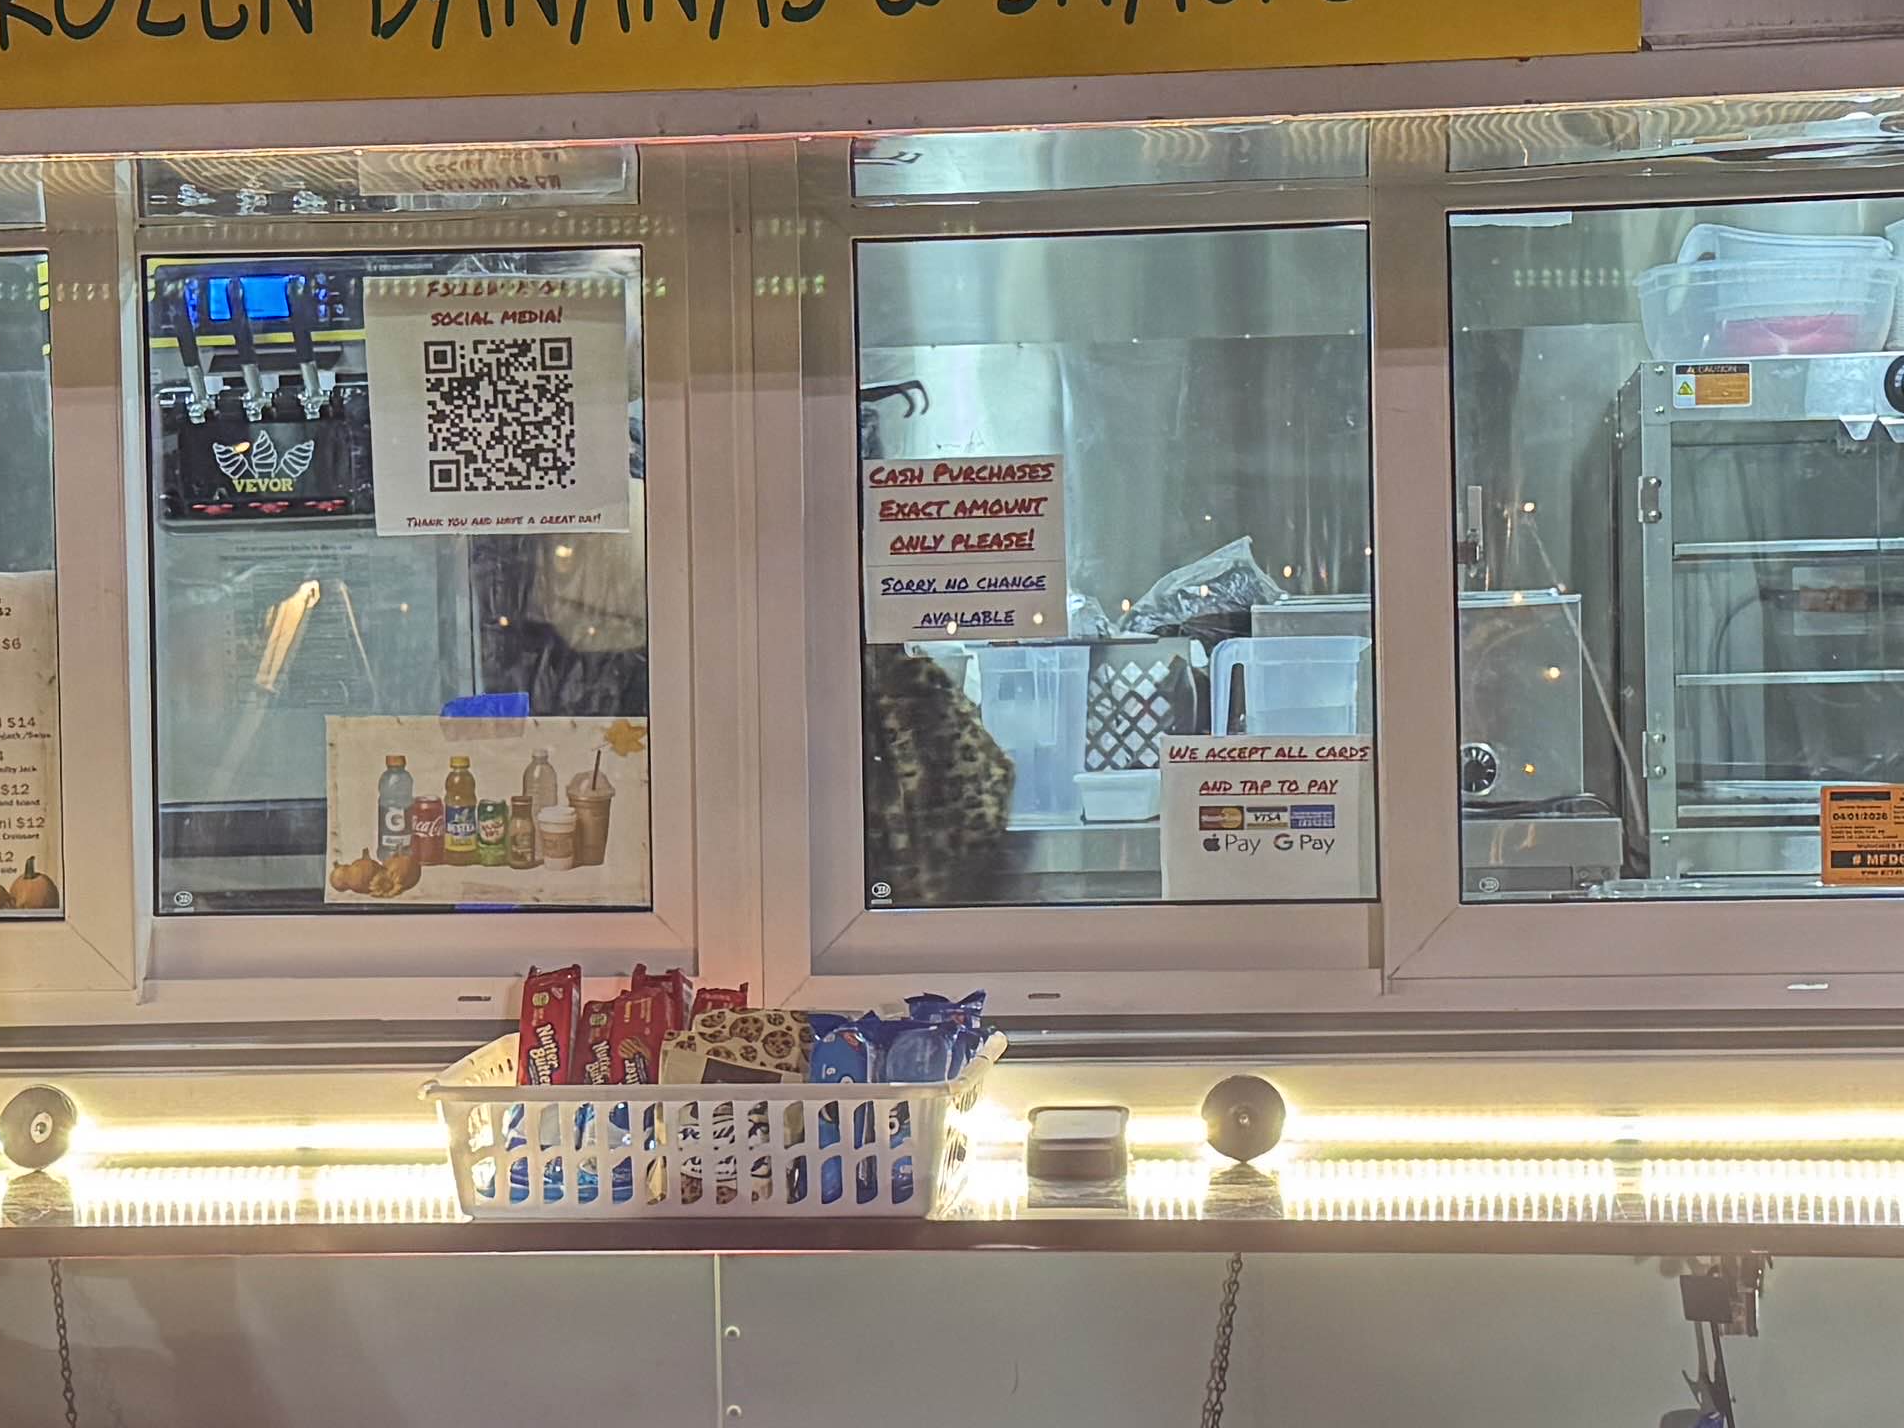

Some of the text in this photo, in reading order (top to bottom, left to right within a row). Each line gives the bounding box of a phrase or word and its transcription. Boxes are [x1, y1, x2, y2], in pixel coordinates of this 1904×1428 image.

[431, 306, 564, 326] SOCIAL MEDIA!
[870, 462, 1056, 485] CASH PURCHASES
[230, 476, 296, 494] VEVOR
[879, 498, 1047, 519] EXACT AMOUNT
[407, 517, 443, 527] THANK
[890, 530, 1035, 552] ONLY PLEASE!
[977, 574, 1046, 590] CHANGE
[921, 610, 1015, 626] AVAILABLE
[1169, 747, 1370, 760] WE ACCEPT ALL CARDS
[1200, 780, 1338, 792] AND TAP TO PAY
[1226, 834, 1334, 855] Pay Pay
